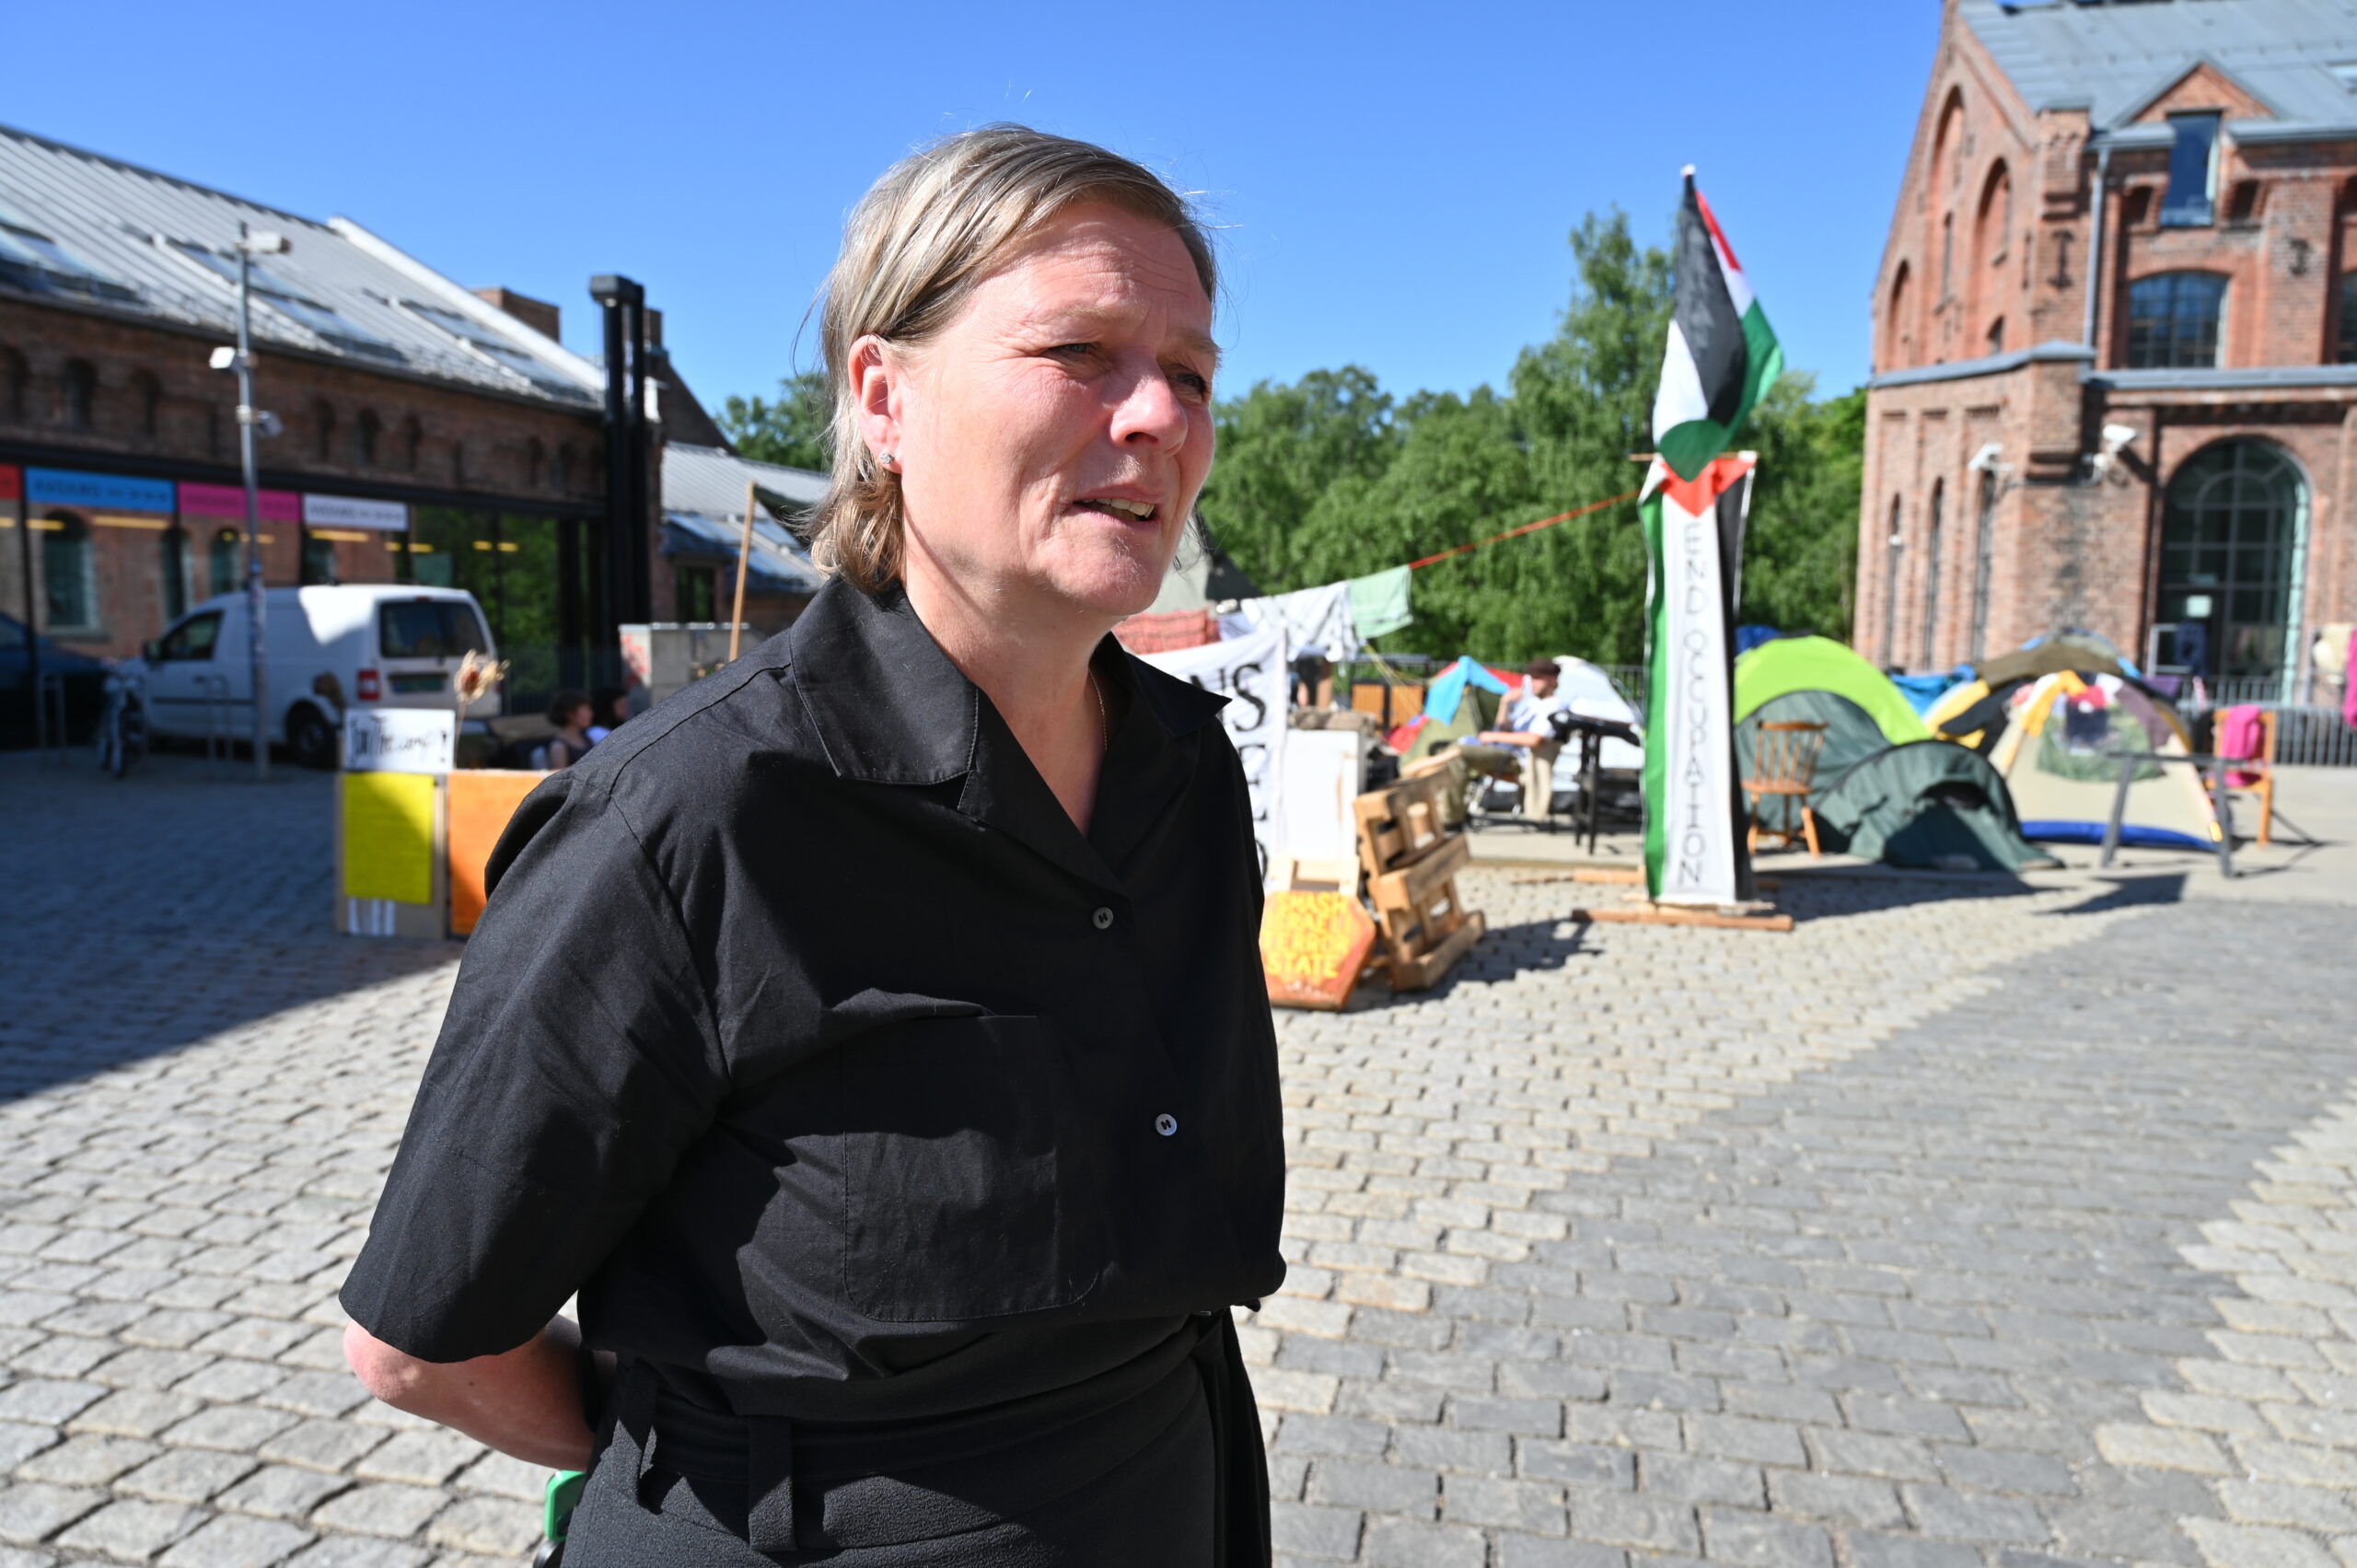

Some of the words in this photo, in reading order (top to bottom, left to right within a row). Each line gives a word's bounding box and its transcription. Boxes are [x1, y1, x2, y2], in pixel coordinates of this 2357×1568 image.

[1684, 521, 1710, 616] END
[1678, 629, 1708, 887] OCCUPATION
[1266, 951, 1340, 979] STATE
